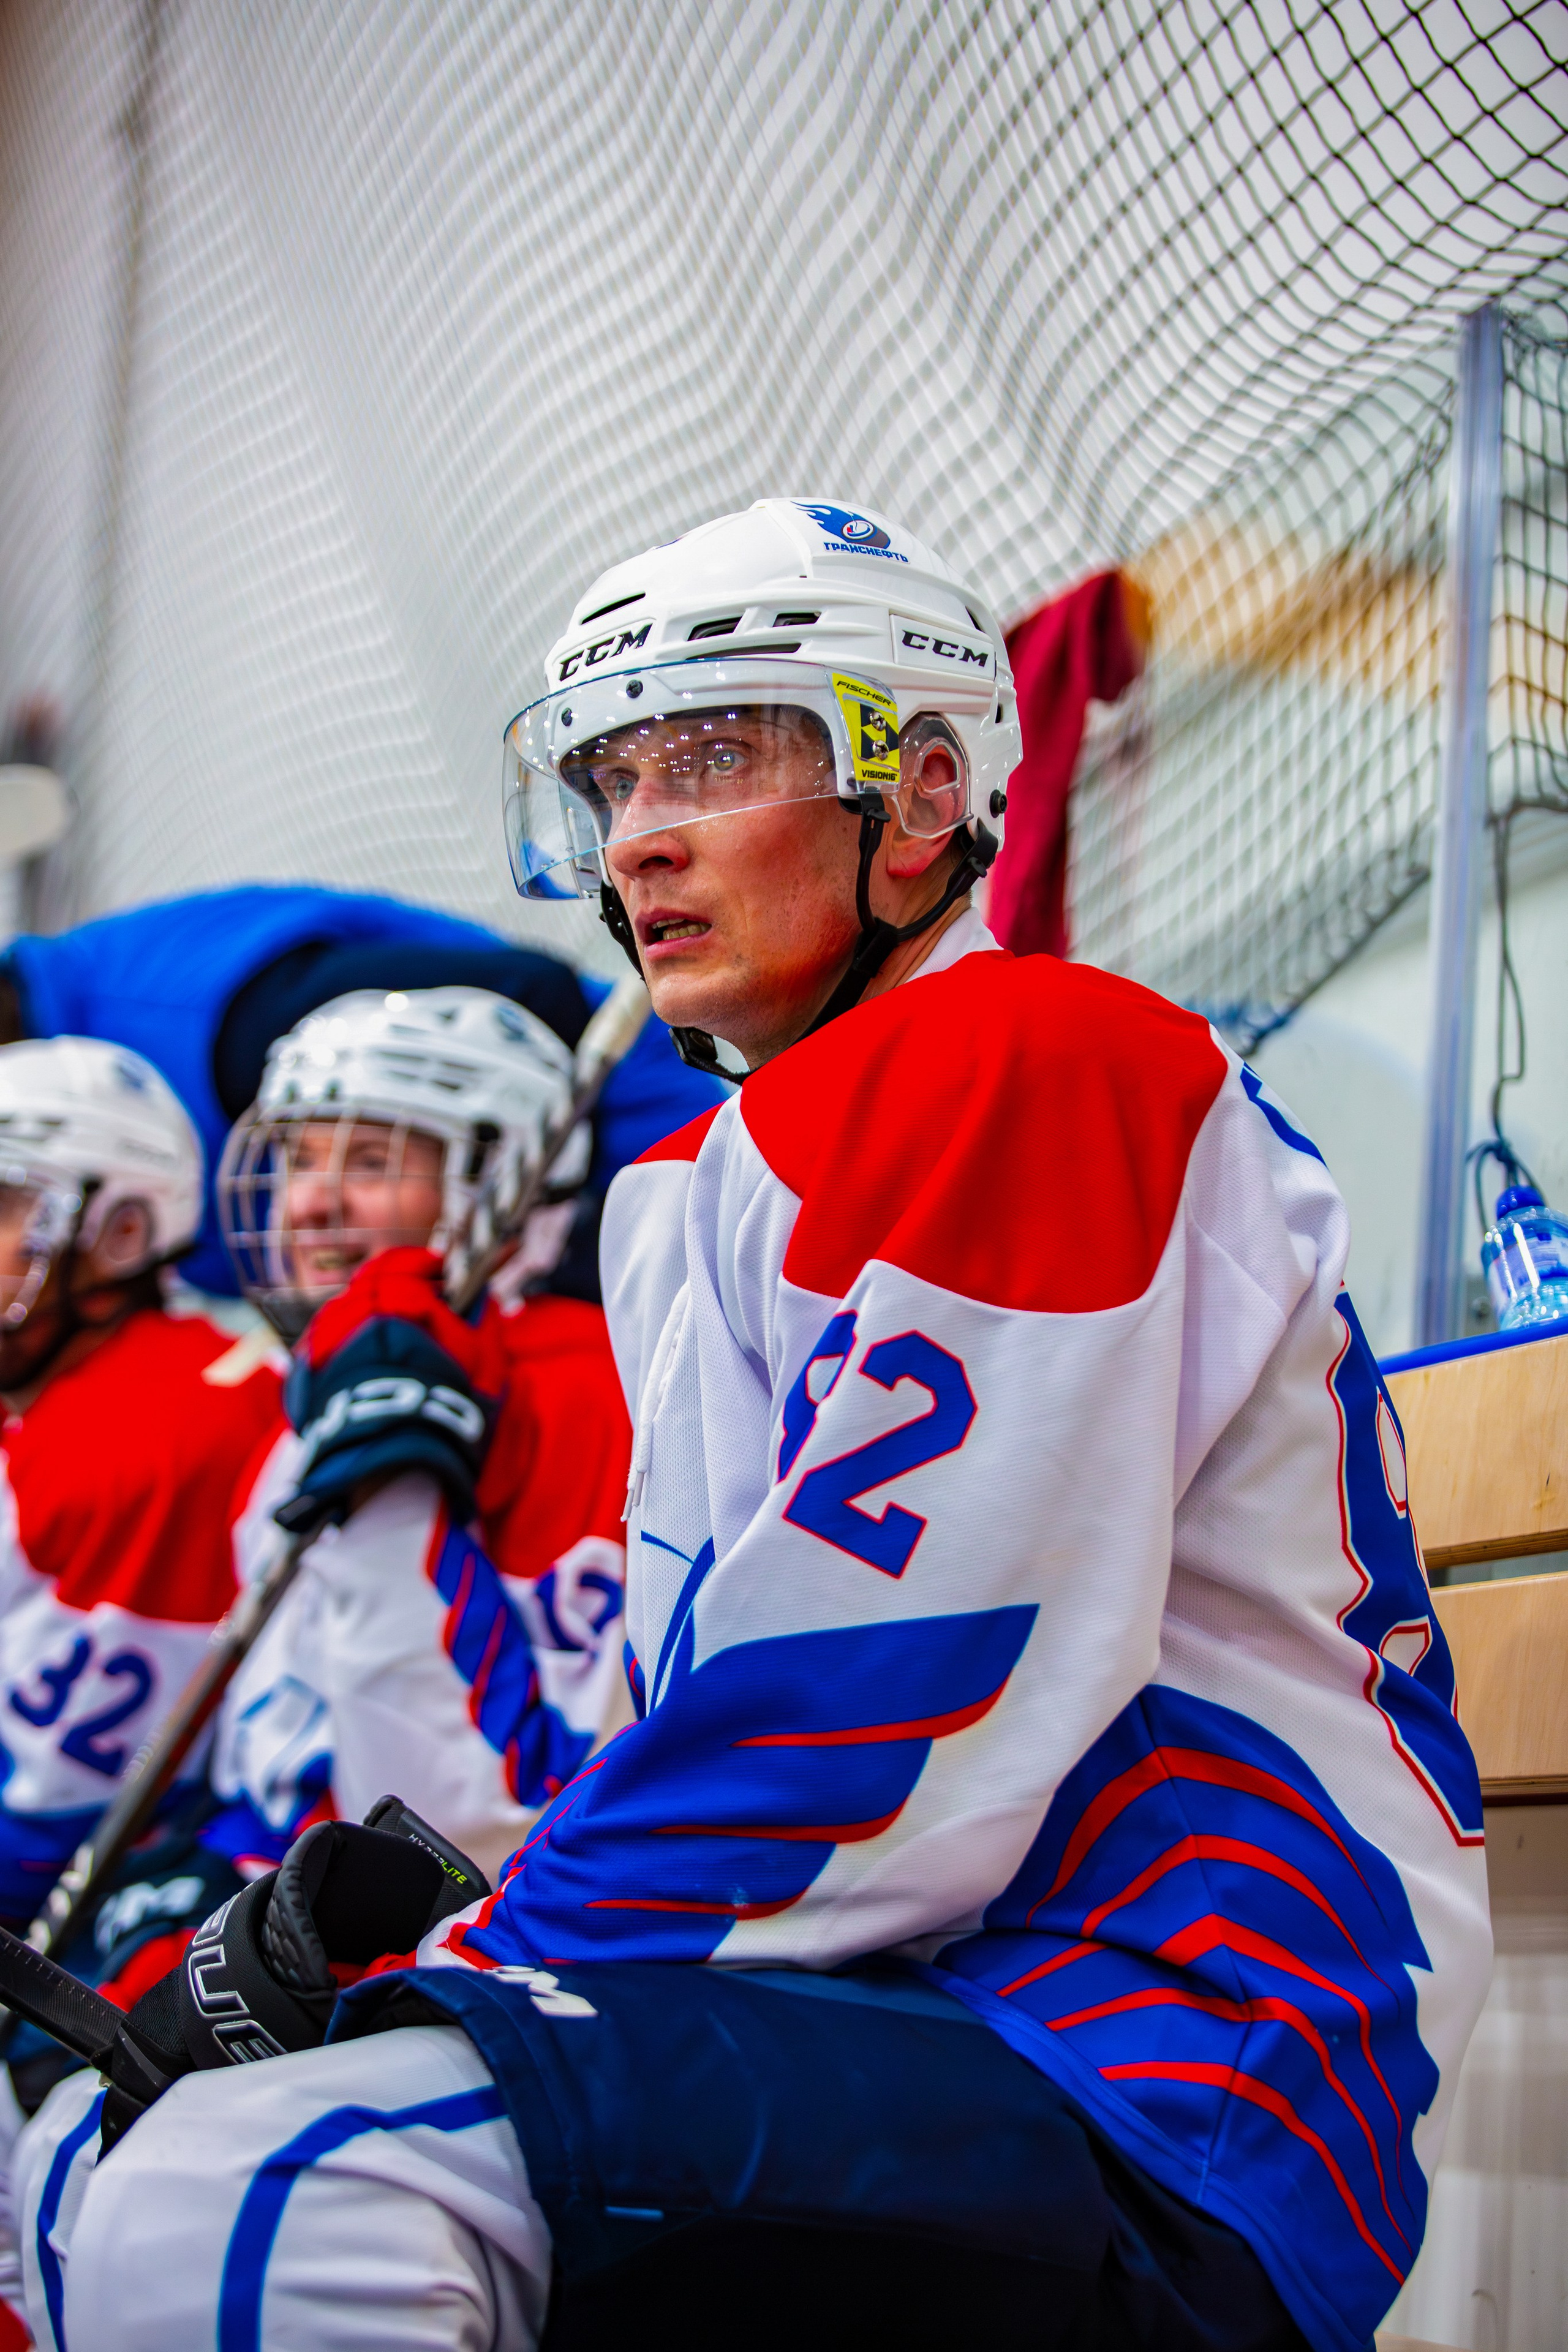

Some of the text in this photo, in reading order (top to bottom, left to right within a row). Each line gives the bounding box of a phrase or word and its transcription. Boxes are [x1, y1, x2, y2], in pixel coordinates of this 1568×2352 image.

[823, 541, 909, 563] ТРАНСНЕФТЬ
[559, 622, 654, 682] CCM
[902, 629, 989, 668] CCM
[837, 680, 891, 706] FISCHER
[10, 1633, 152, 1777] 32
